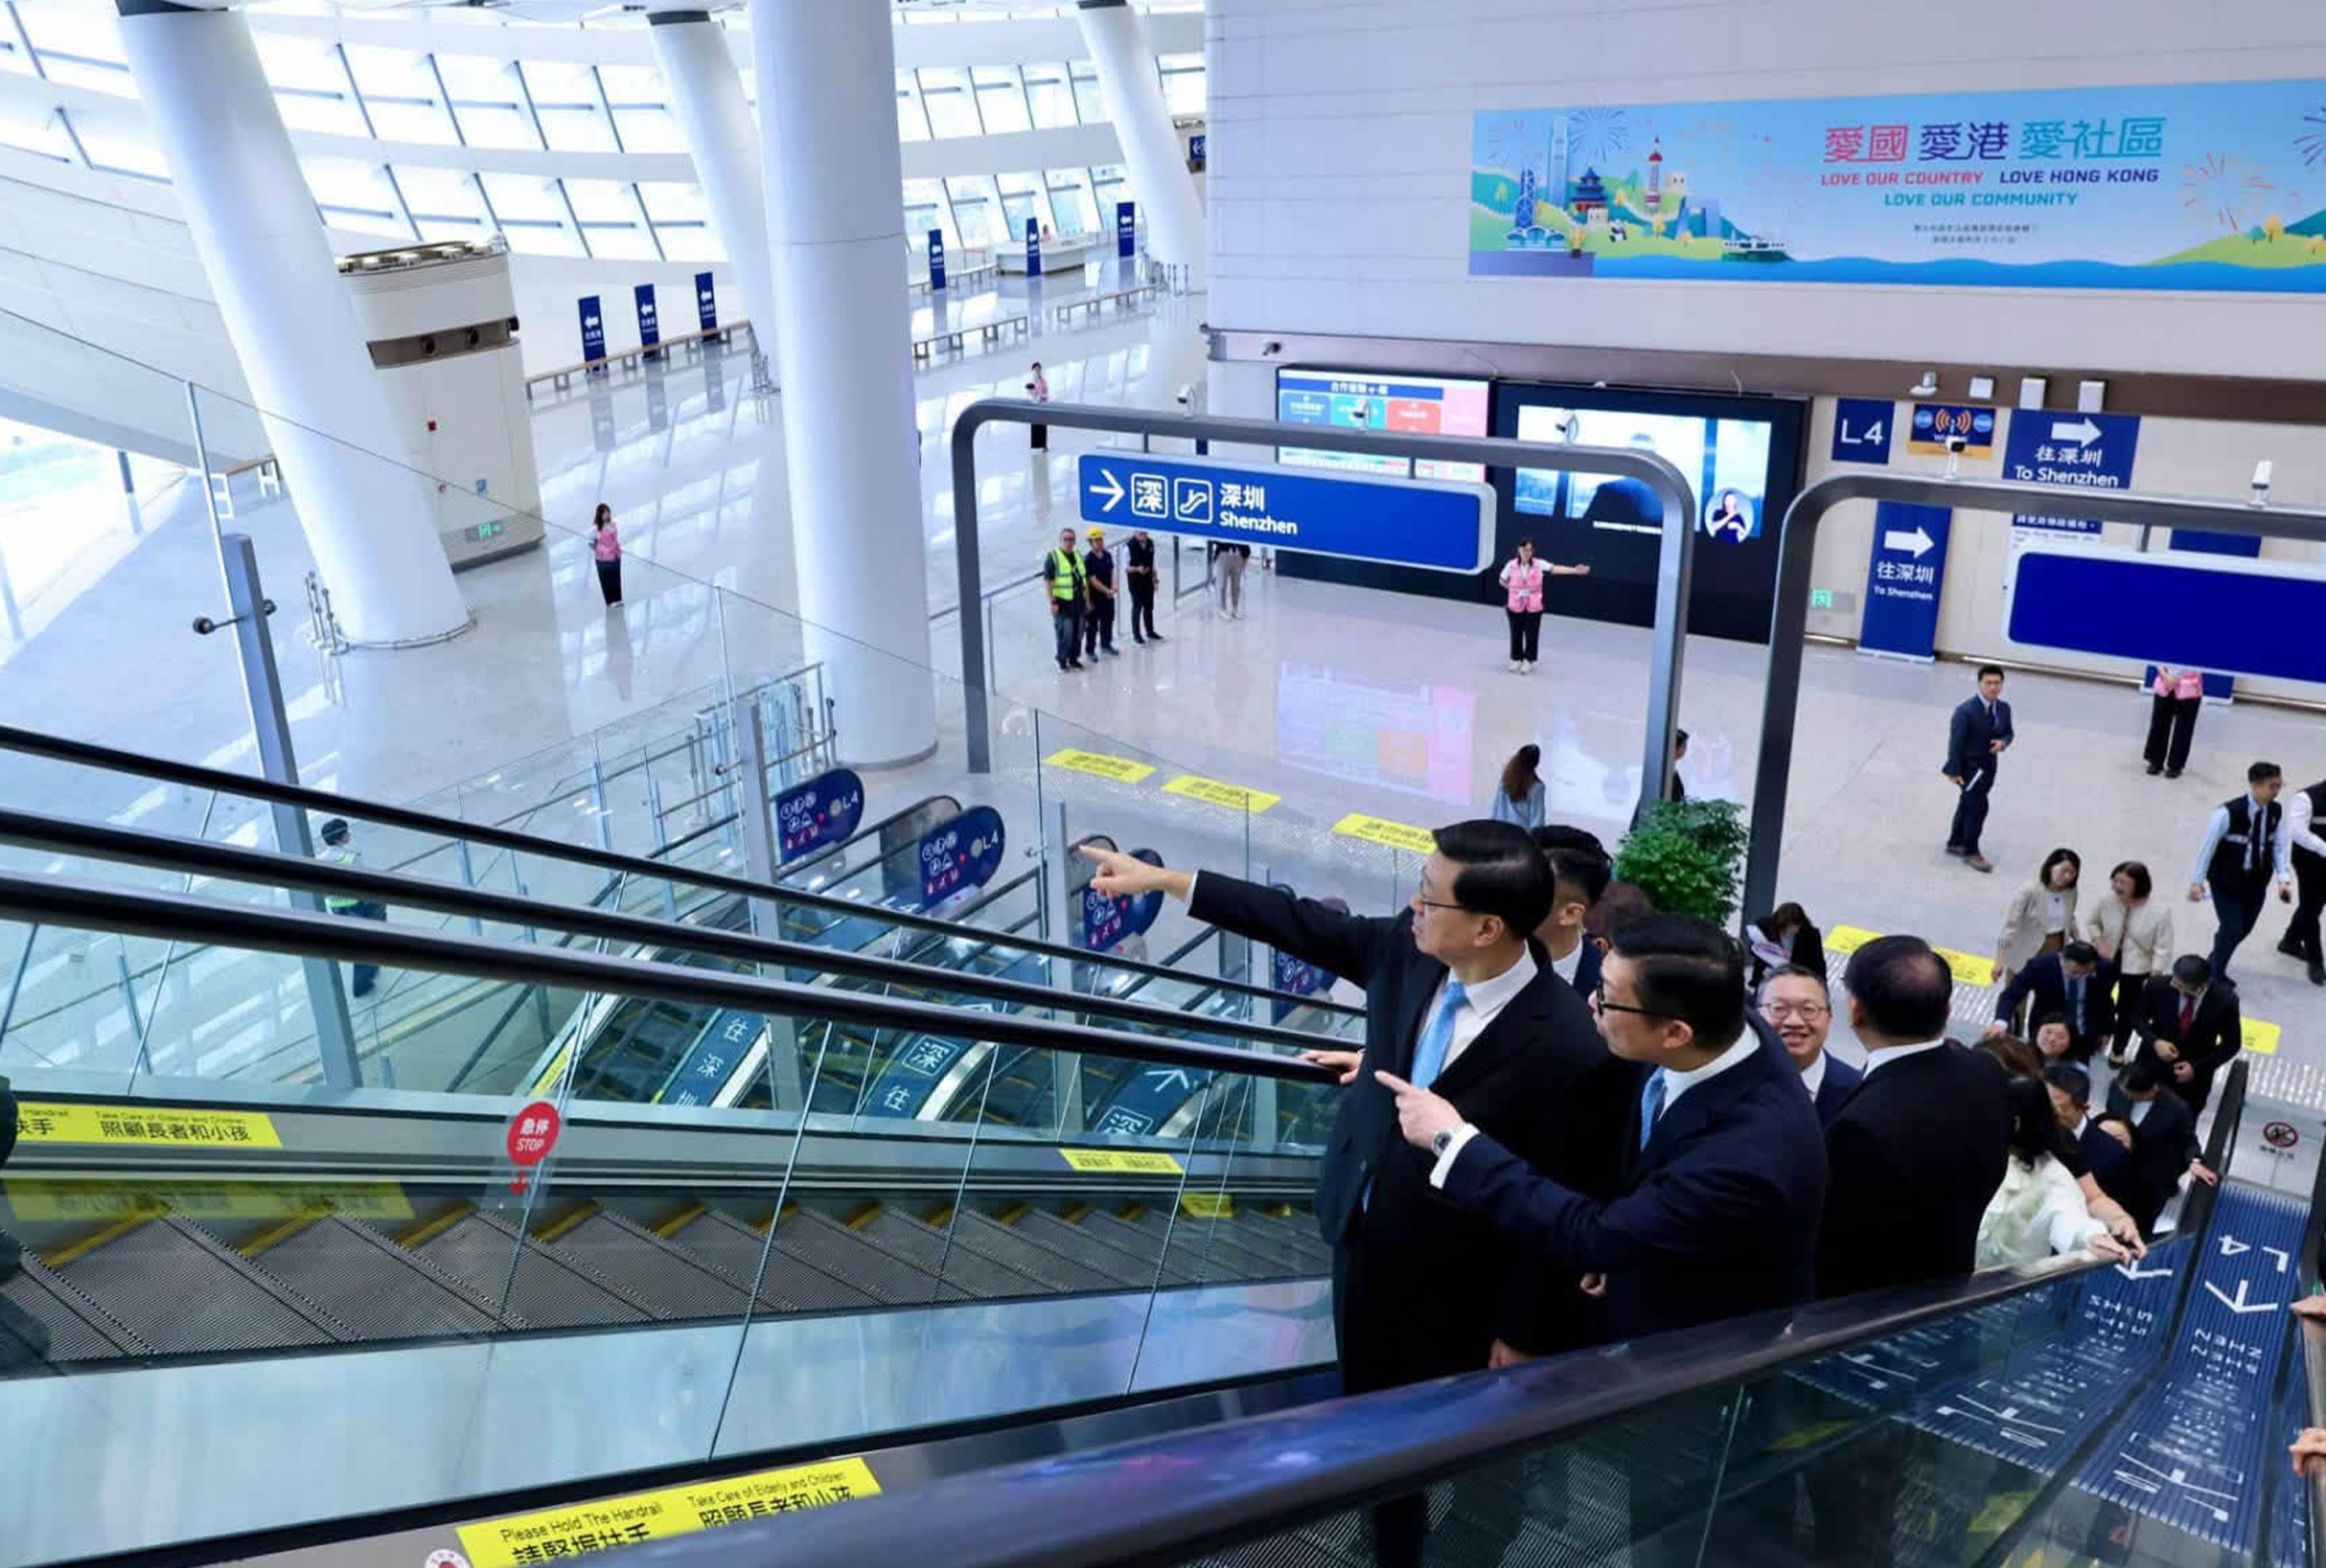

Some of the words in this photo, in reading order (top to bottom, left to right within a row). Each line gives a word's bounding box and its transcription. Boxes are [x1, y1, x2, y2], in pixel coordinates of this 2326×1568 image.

[1823, 125, 1908, 162] 愛國
[1918, 123, 2009, 161] 愛港
[2019, 118, 2166, 160] 愛社區
[1821, 173, 1860, 186] LOVE
[1866, 173, 1899, 185] OUR
[1905, 171, 1984, 185] COUNTRY
[1999, 171, 2044, 183] LOVE
[2050, 170, 2100, 182] HONG
[2107, 170, 2159, 182] KONG
[1884, 194, 1925, 206] LOVE
[1931, 194, 1965, 206] OUR
[1972, 193, 2078, 206] COMMUNITY
[1841, 419, 1883, 445] L4
[2035, 445, 2103, 468] 往深圳
[2014, 466, 2032, 481] To
[2037, 467, 2119, 488] Shenzhen
[1136, 481, 1162, 513] 深
[1220, 483, 1265, 511] 深圳
[1219, 510, 1298, 535] Shenzhen
[1876, 561, 1934, 584] 往深圳
[1874, 585, 1886, 595] To
[1888, 586, 1933, 600] Shenzhen
[842, 790, 858, 809] L4
[982, 829, 998, 849] L4
[100, 1121, 251, 1141] 照顧長者和小孩
[517, 1138, 545, 1152] STOP
[2218, 1235, 2289, 1274] L4
[500, 1528, 547, 1542] Please
[550, 1517, 583, 1533] Hold
[583, 1512, 609, 1527] The
[611, 1503, 663, 1523] Handrail
[687, 1495, 716, 1508] Take
[716, 1491, 741, 1503] Care
[742, 1485, 752, 1498] of
[754, 1482, 788, 1496] Elderly
[789, 1478, 808, 1489] and
